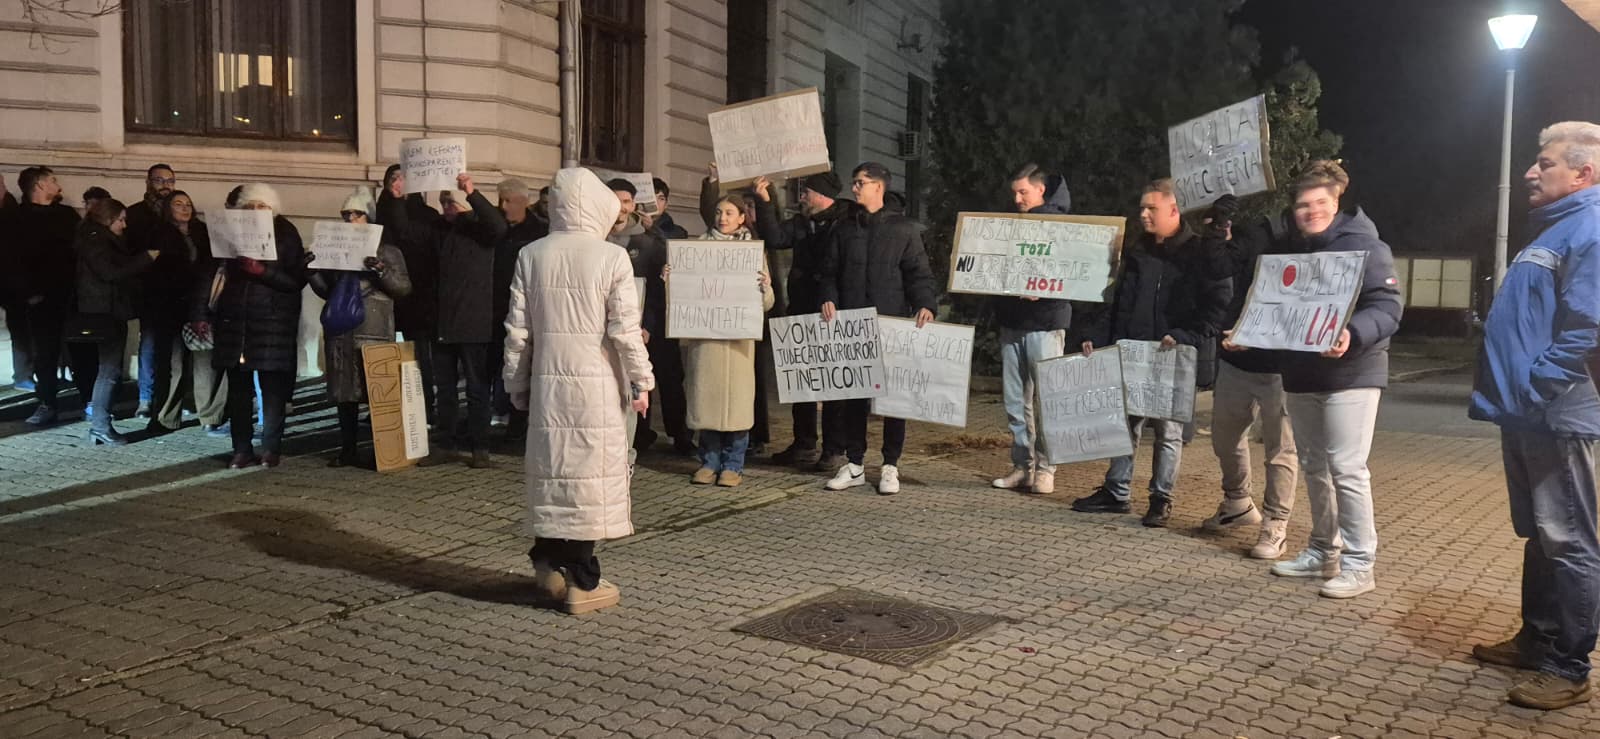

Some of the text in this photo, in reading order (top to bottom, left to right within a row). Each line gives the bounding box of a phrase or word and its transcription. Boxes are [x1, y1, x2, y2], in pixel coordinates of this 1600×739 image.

[956, 255, 976, 273] NU
[702, 278, 725, 299] NU
[674, 303, 753, 329] IMUNITATE
[774, 323, 816, 344] VOM
[819, 321, 830, 341] FI
[926, 333, 969, 363] BLOCAT
